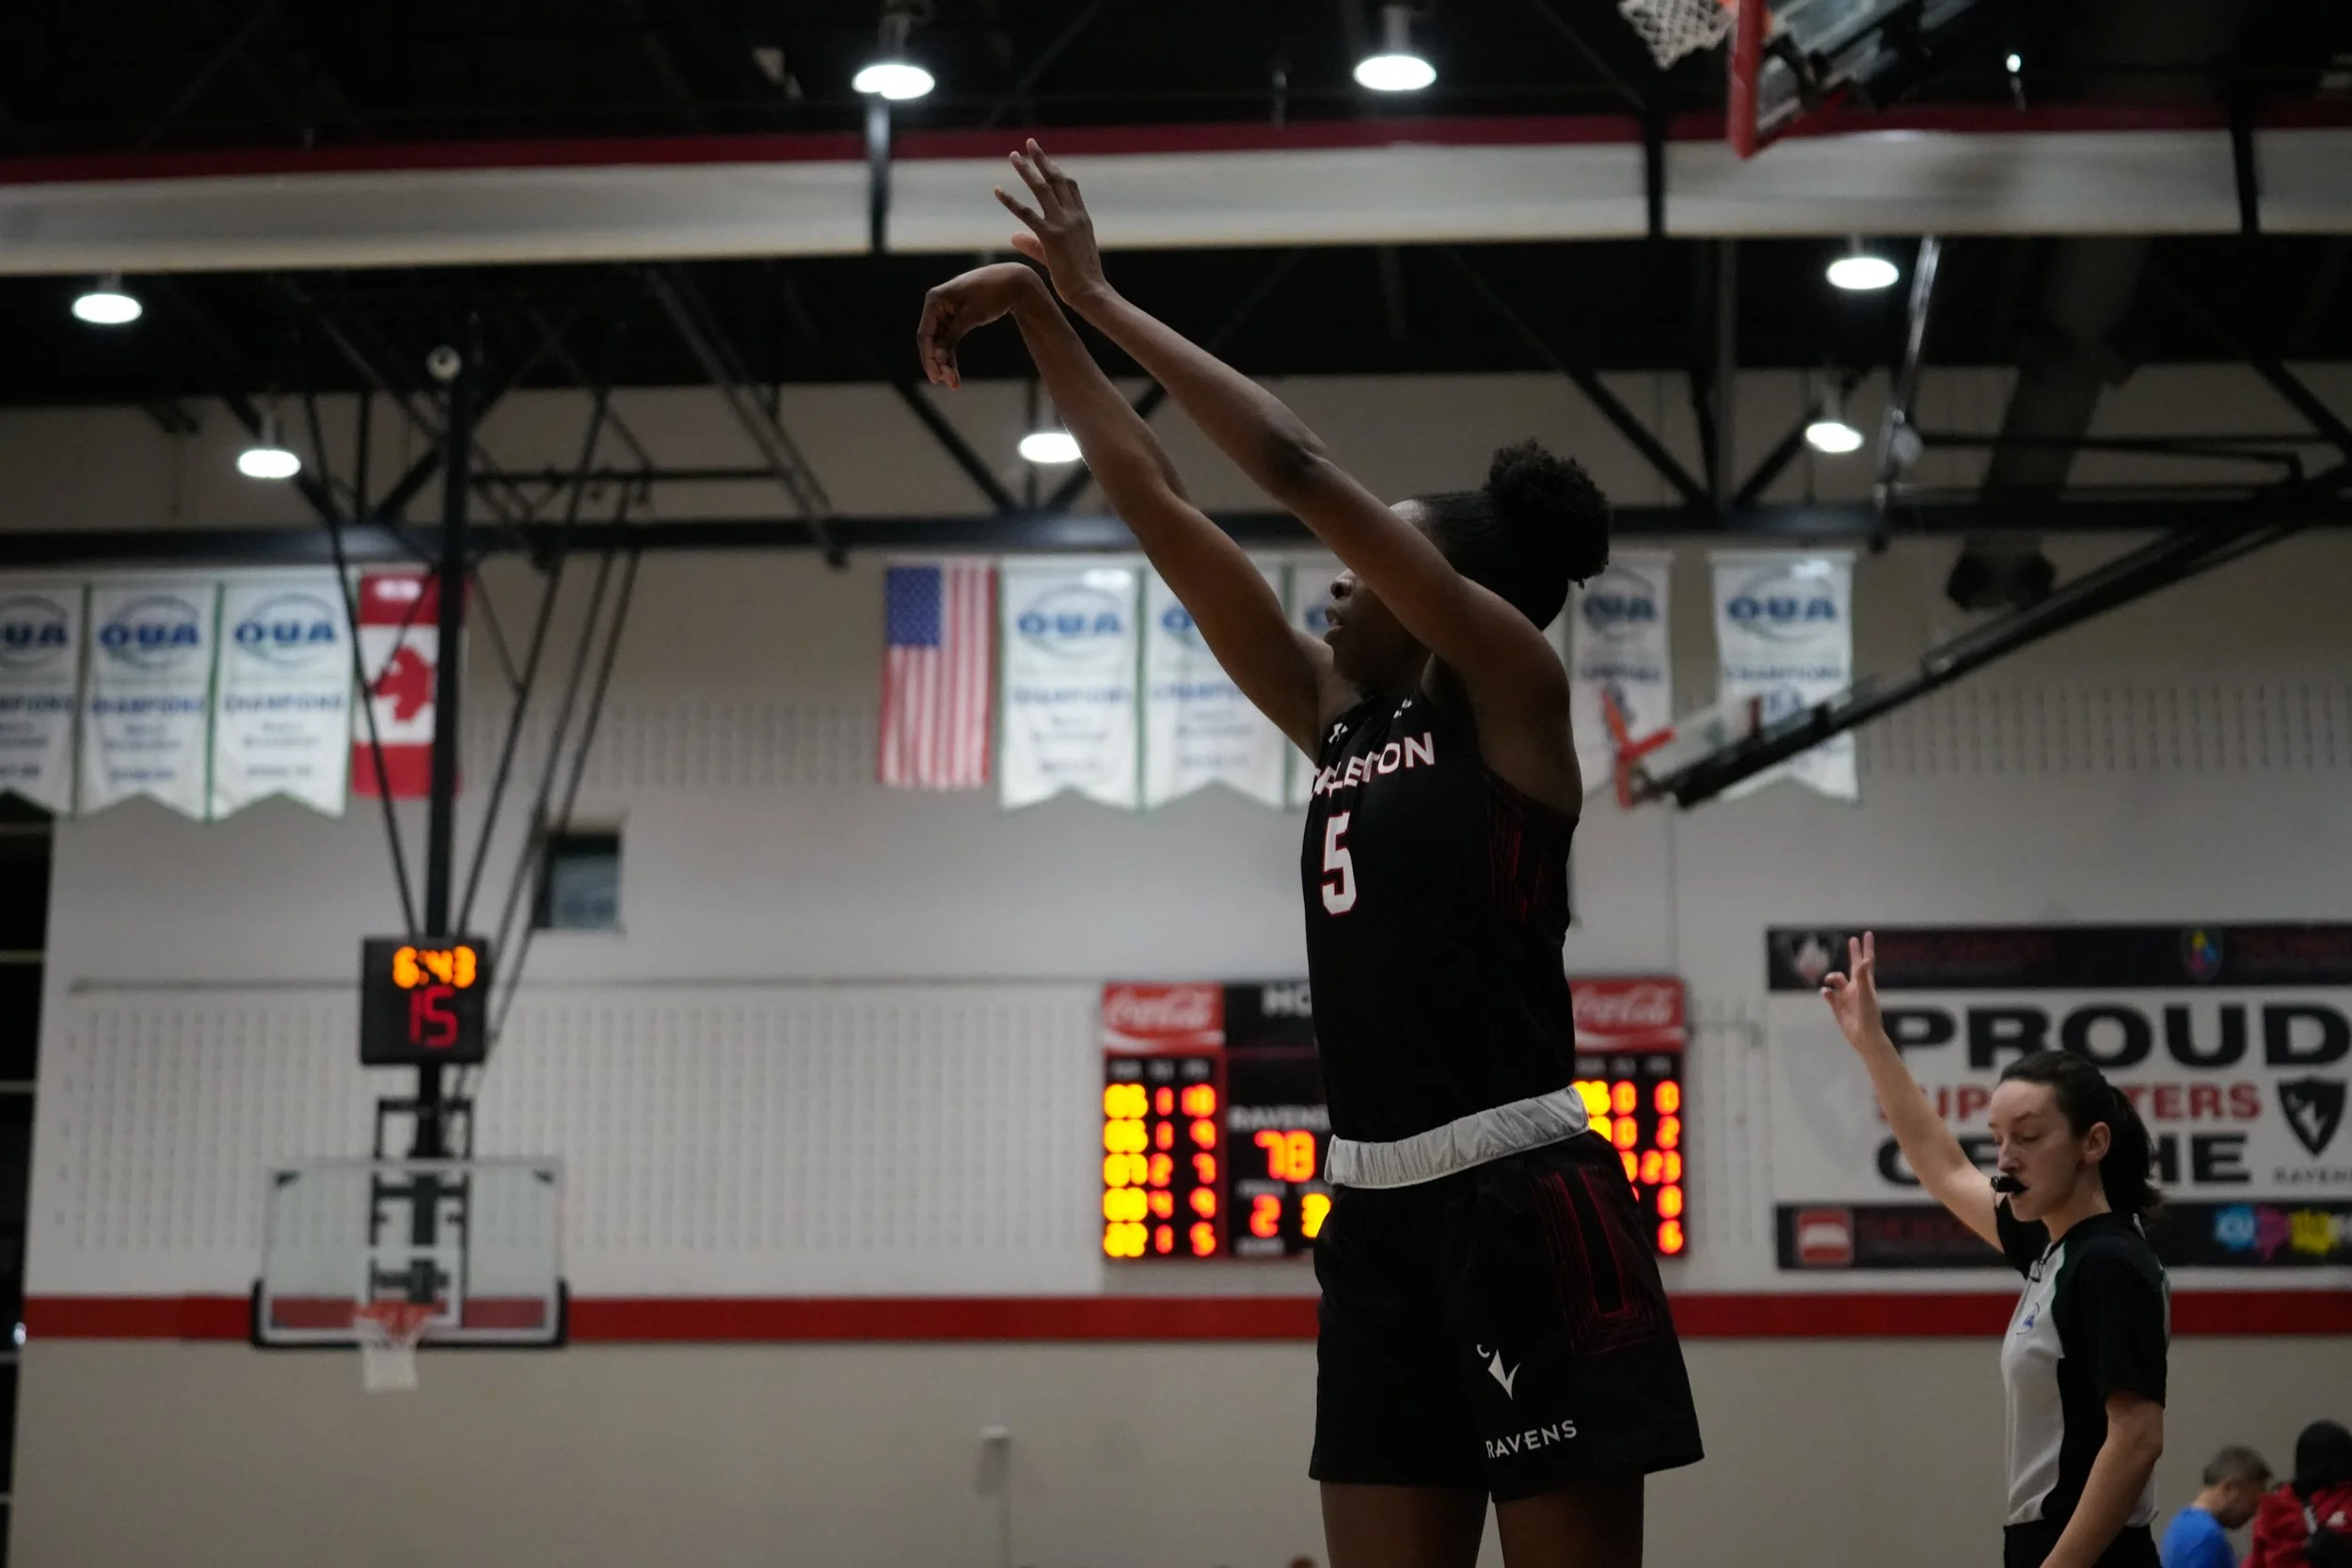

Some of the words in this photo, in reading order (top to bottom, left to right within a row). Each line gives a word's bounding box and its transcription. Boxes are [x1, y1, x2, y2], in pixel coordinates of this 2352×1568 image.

[1725, 594, 1837, 622] OUA
[0, 620, 69, 647] UA
[100, 620, 200, 647] OUA
[234, 620, 336, 645] OUA
[1017, 610, 1122, 636] OUA
[1321, 810, 1357, 917] 5
[409, 984, 458, 1048] 15
[1881, 1003, 2350, 1069] PROUD
[1227, 1104, 1331, 1132] RAVEN
[1486, 1419, 1578, 1459] RAVENS
